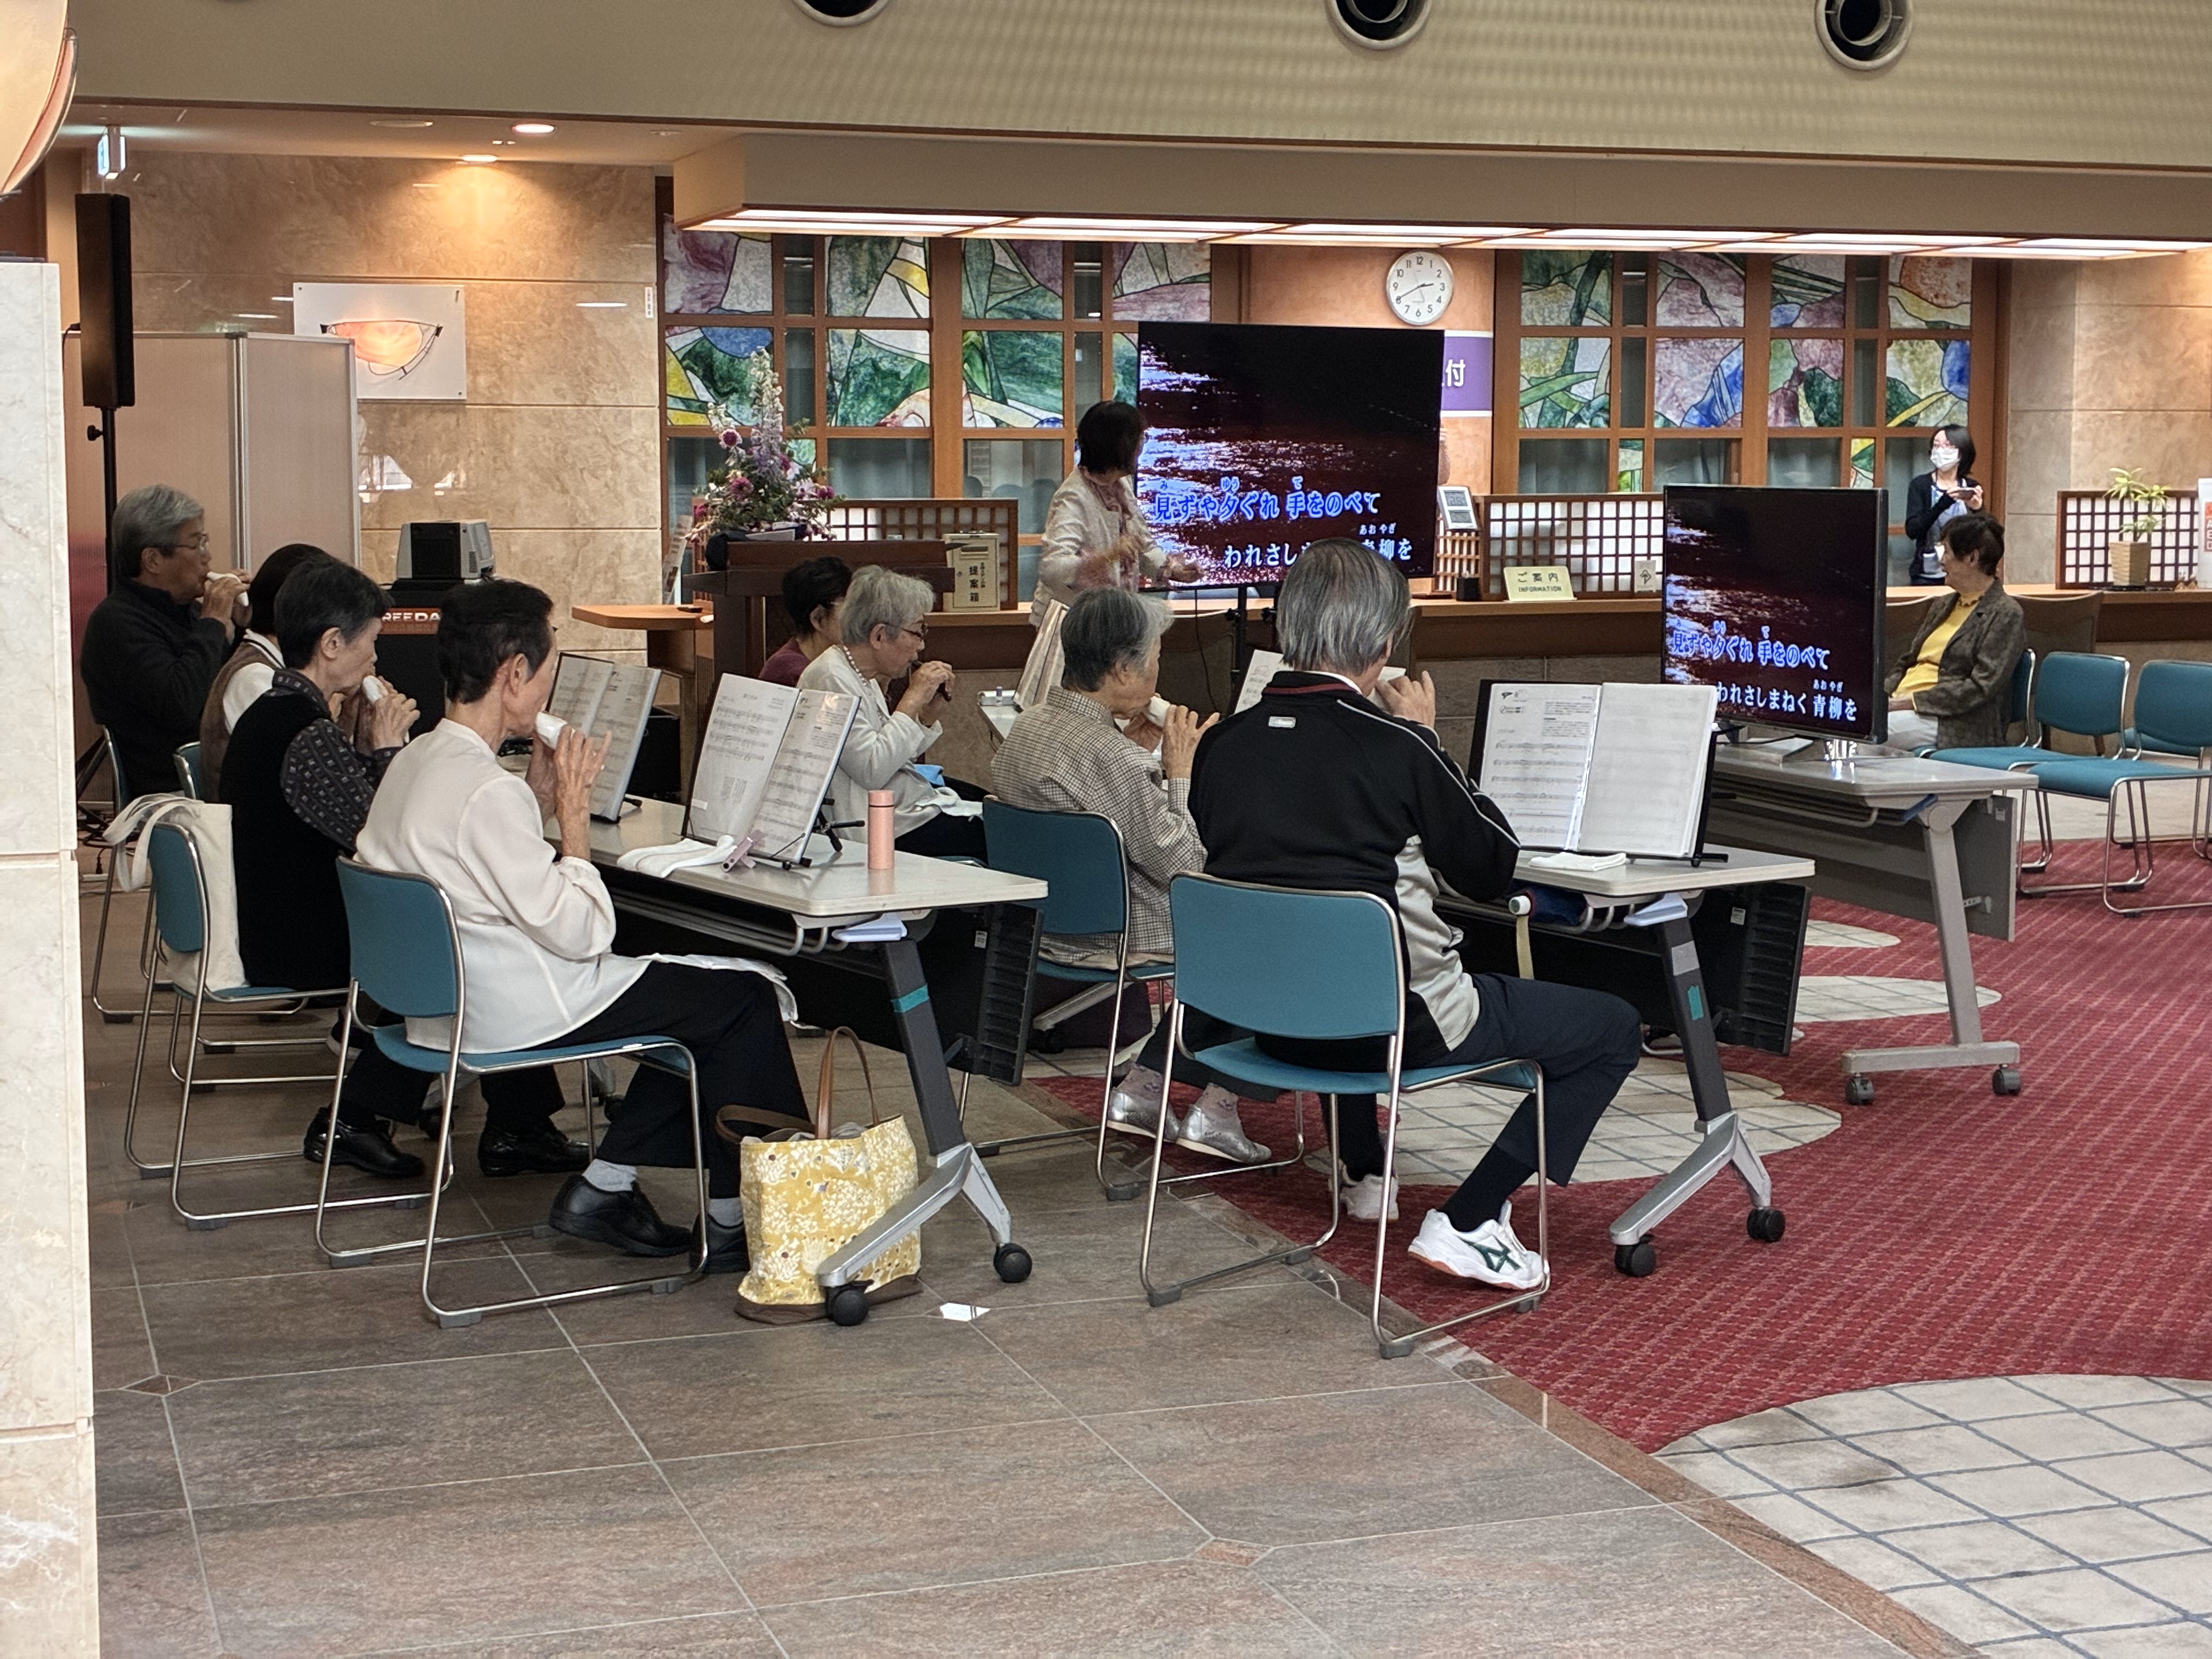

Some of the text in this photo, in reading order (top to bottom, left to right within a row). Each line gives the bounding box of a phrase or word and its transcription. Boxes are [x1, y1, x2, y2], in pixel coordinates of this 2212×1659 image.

[1406, 259, 1411, 268] 11
[1417, 256, 1423, 265] 12
[1430, 259, 1432, 268] 1
[1396, 269, 1404, 278] 10
[1437, 269, 1442, 278] 2
[1393, 282, 1398, 291] 9
[1440, 283, 1445, 291] 3
[1396, 296, 1402, 304] 8
[1436, 295, 1442, 303] 4
[1405, 305, 1410, 313] 7
[1416, 308, 1421, 317] 6
[1427, 304, 1433, 313] 5
[1442, 359, 1466, 387] 付
[1292, 476, 1303, 490] て
[1153, 490, 1380, 522] 見ずや夕ぐれ 手をのべて
[1224, 542, 1311, 568] われさし
[1517, 571, 1559, 583] ご案内
[969, 565, 980, 602] 提案箱
[382, 612, 441, 622] REEDA
[1757, 640, 1830, 670] 手をのべて
[1716, 681, 1857, 721] われさしまねく 青柳を
